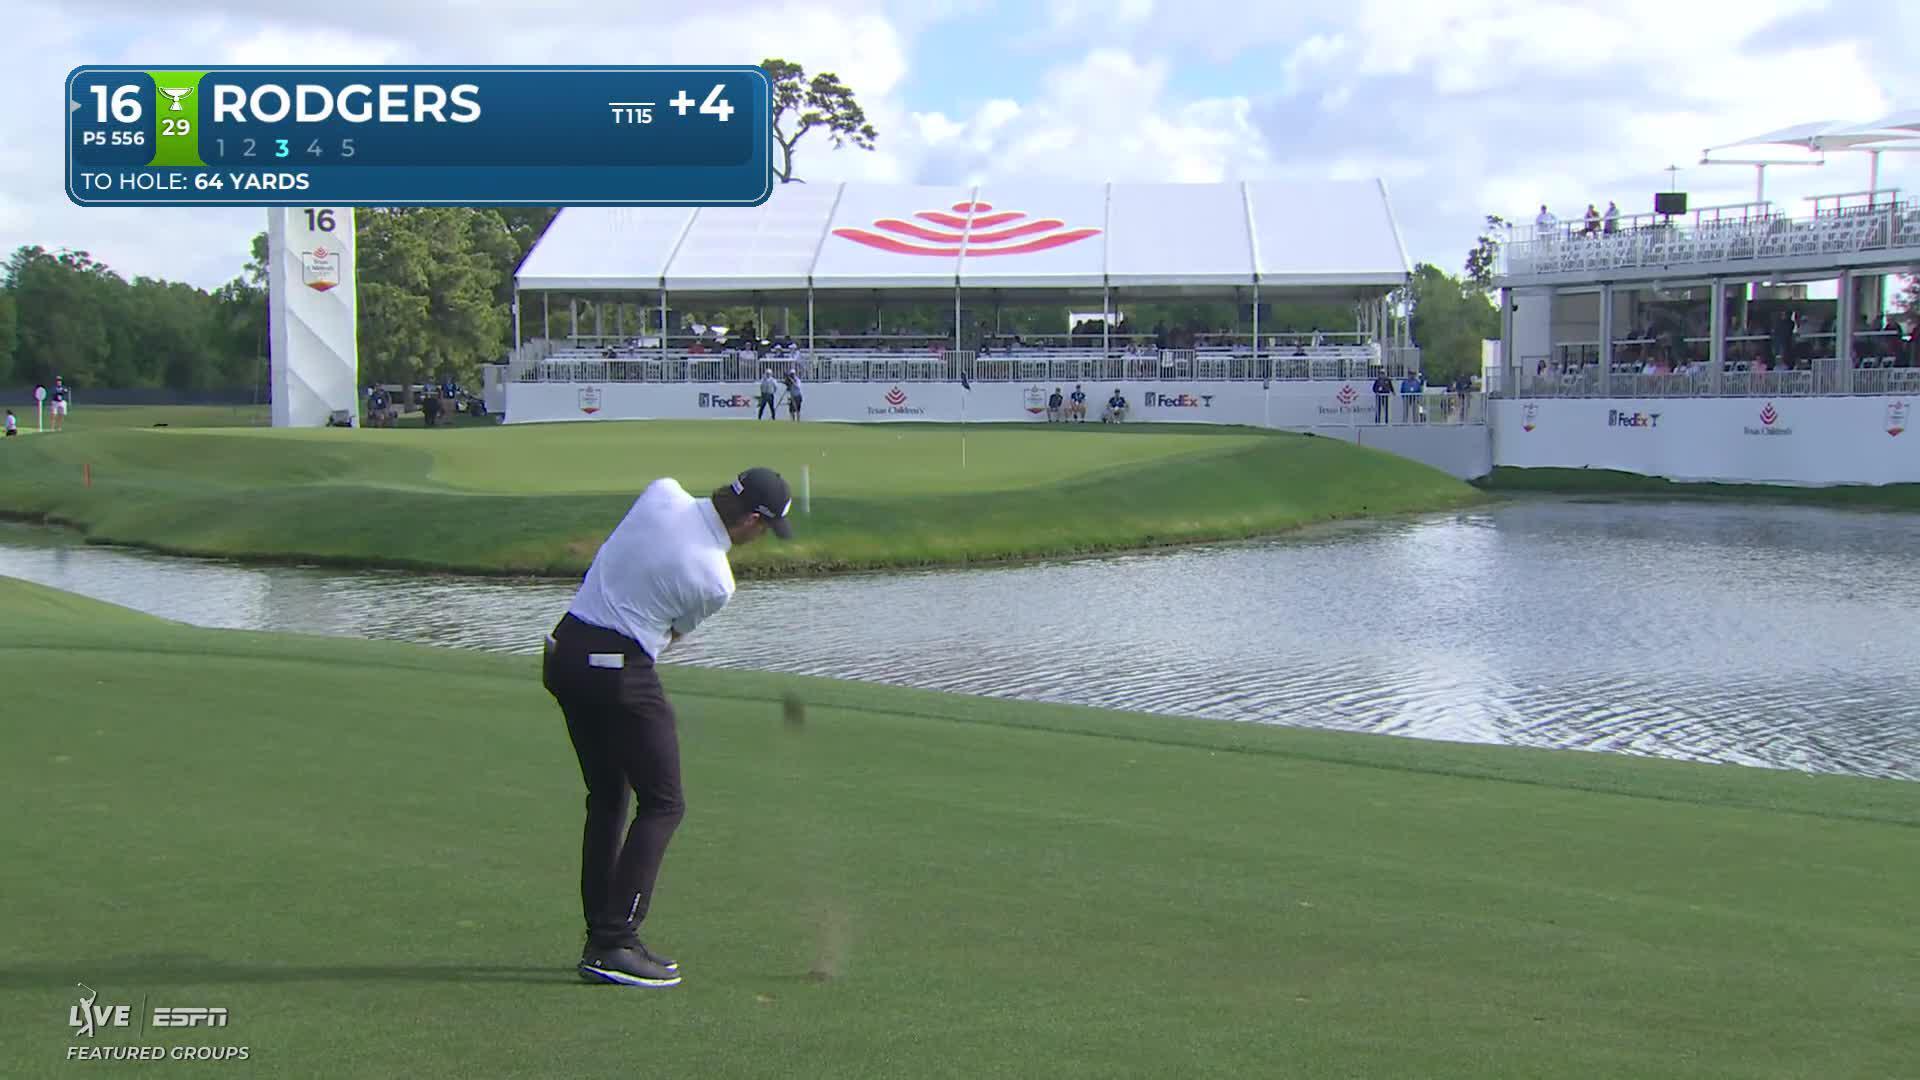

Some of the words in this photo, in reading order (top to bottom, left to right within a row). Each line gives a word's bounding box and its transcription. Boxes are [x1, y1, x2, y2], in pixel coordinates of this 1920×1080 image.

[304, 208, 336, 232] 16
[711, 394, 751, 408] FedEx
[1158, 394, 1199, 408] FedEx
[1618, 412, 1648, 427] FedEx
